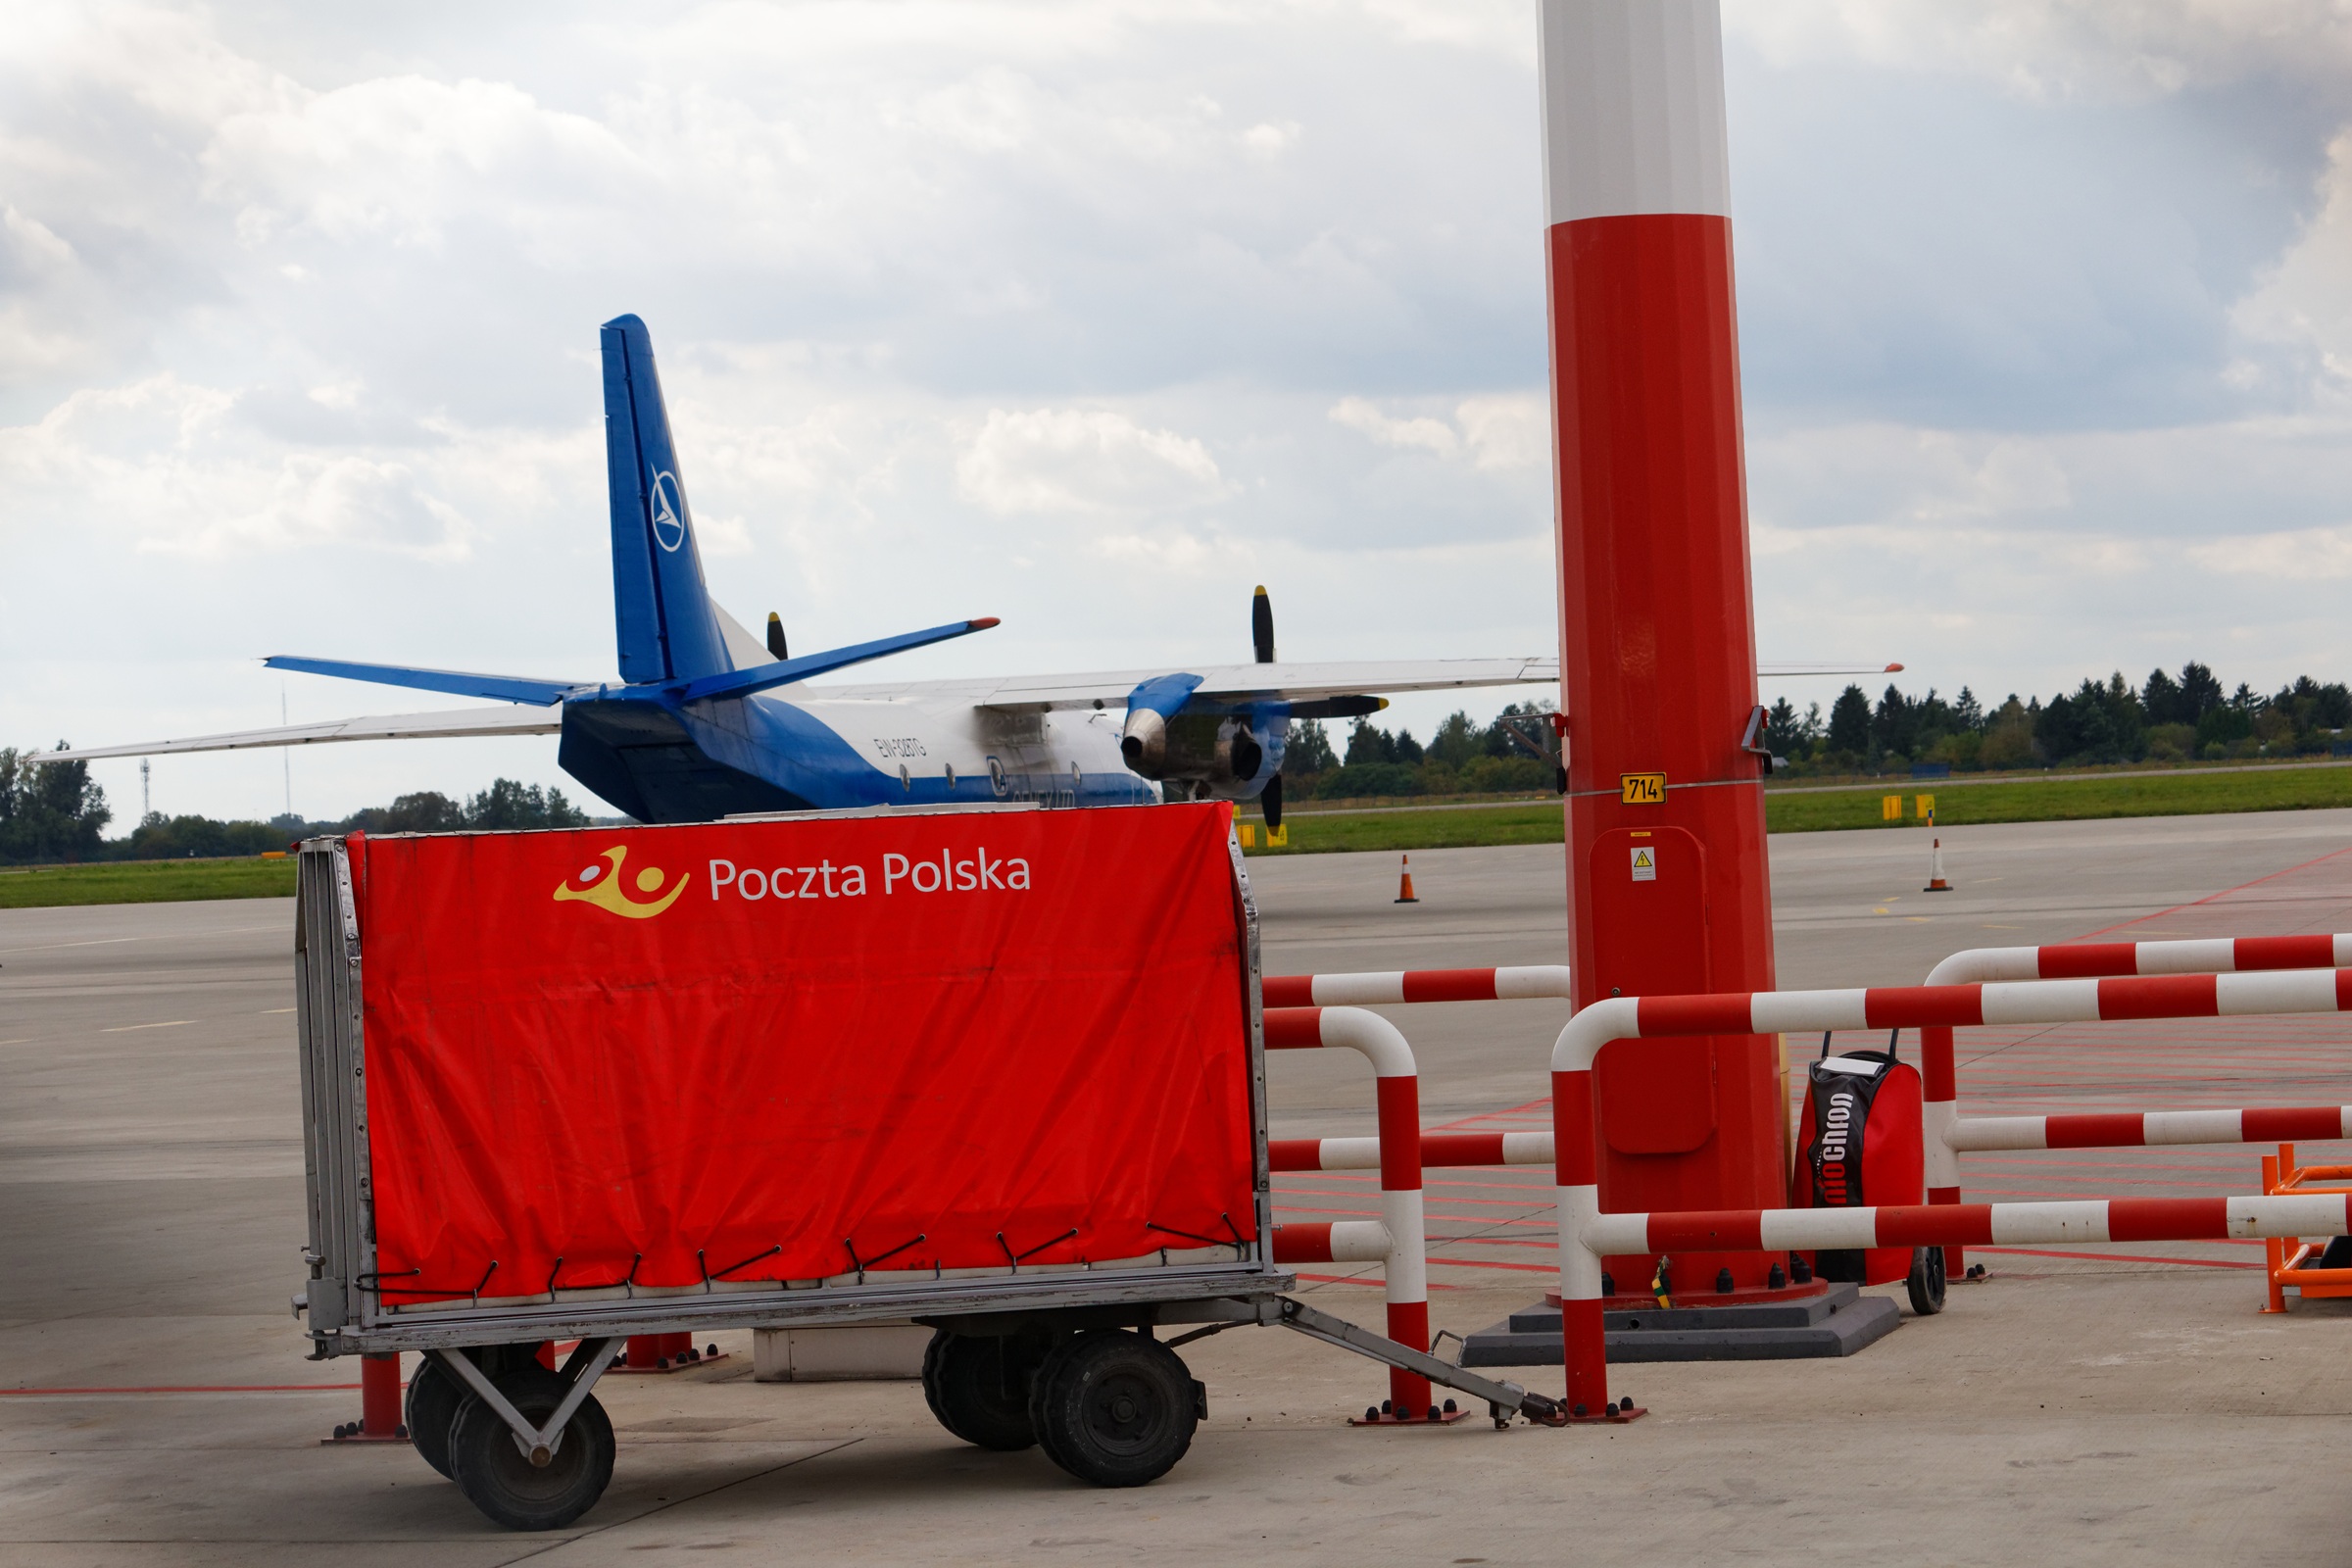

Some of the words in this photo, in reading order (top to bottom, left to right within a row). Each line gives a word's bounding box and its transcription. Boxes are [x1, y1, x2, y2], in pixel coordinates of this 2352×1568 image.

[873, 738, 927, 758] EW-328TG
[1629, 779, 1657, 799] 714
[709, 858, 866, 901] Poczta
[883, 847, 1031, 895] Polska
[1817, 1093, 1854, 1206] niochron
